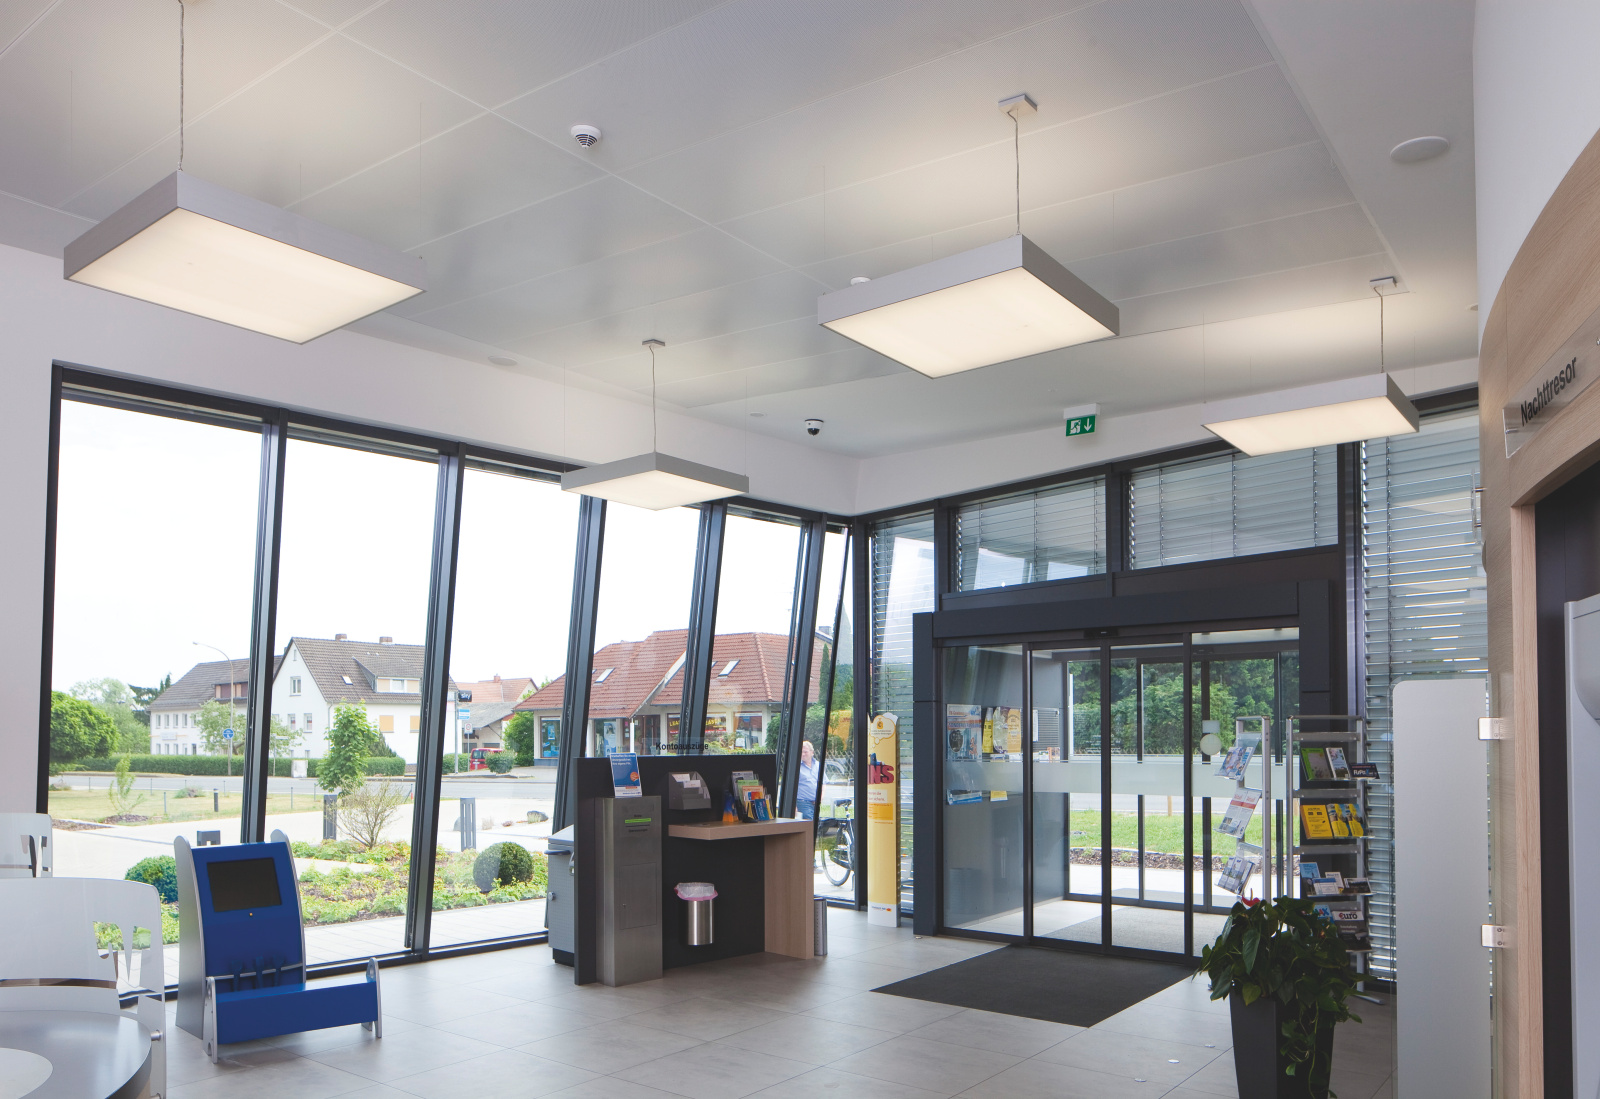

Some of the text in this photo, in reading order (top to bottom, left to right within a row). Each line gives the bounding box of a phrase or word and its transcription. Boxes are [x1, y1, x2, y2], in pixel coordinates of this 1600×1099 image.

[1520, 356, 1577, 427] Nachttresor
[460, 692, 471, 700] sky
[655, 741, 709, 752] Kontoauszüge
[867, 763, 894, 784] NS
